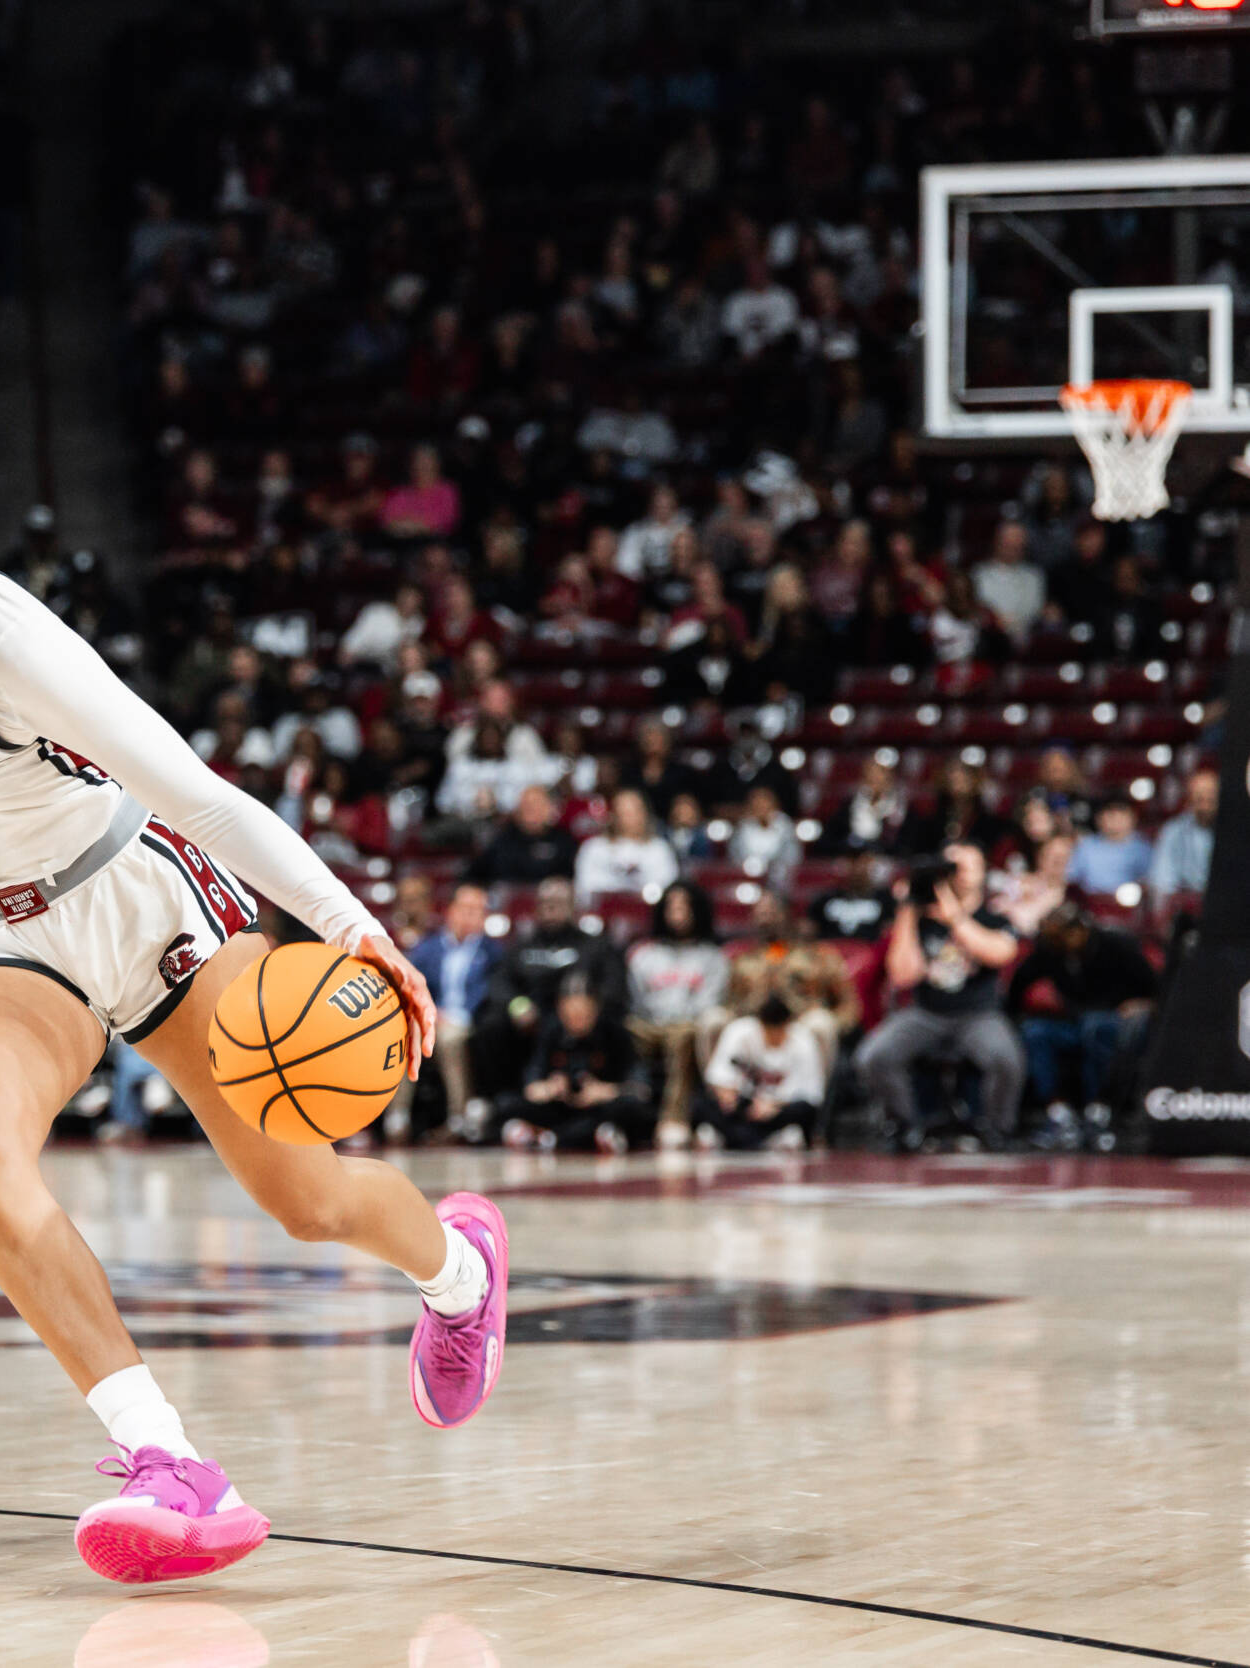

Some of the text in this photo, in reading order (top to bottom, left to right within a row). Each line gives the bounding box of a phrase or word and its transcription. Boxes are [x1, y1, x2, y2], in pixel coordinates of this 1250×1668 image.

[0, 889, 35, 907] CAROLINA
[11, 899, 35, 913] SOUTH
[383, 1039, 407, 1071] EV
